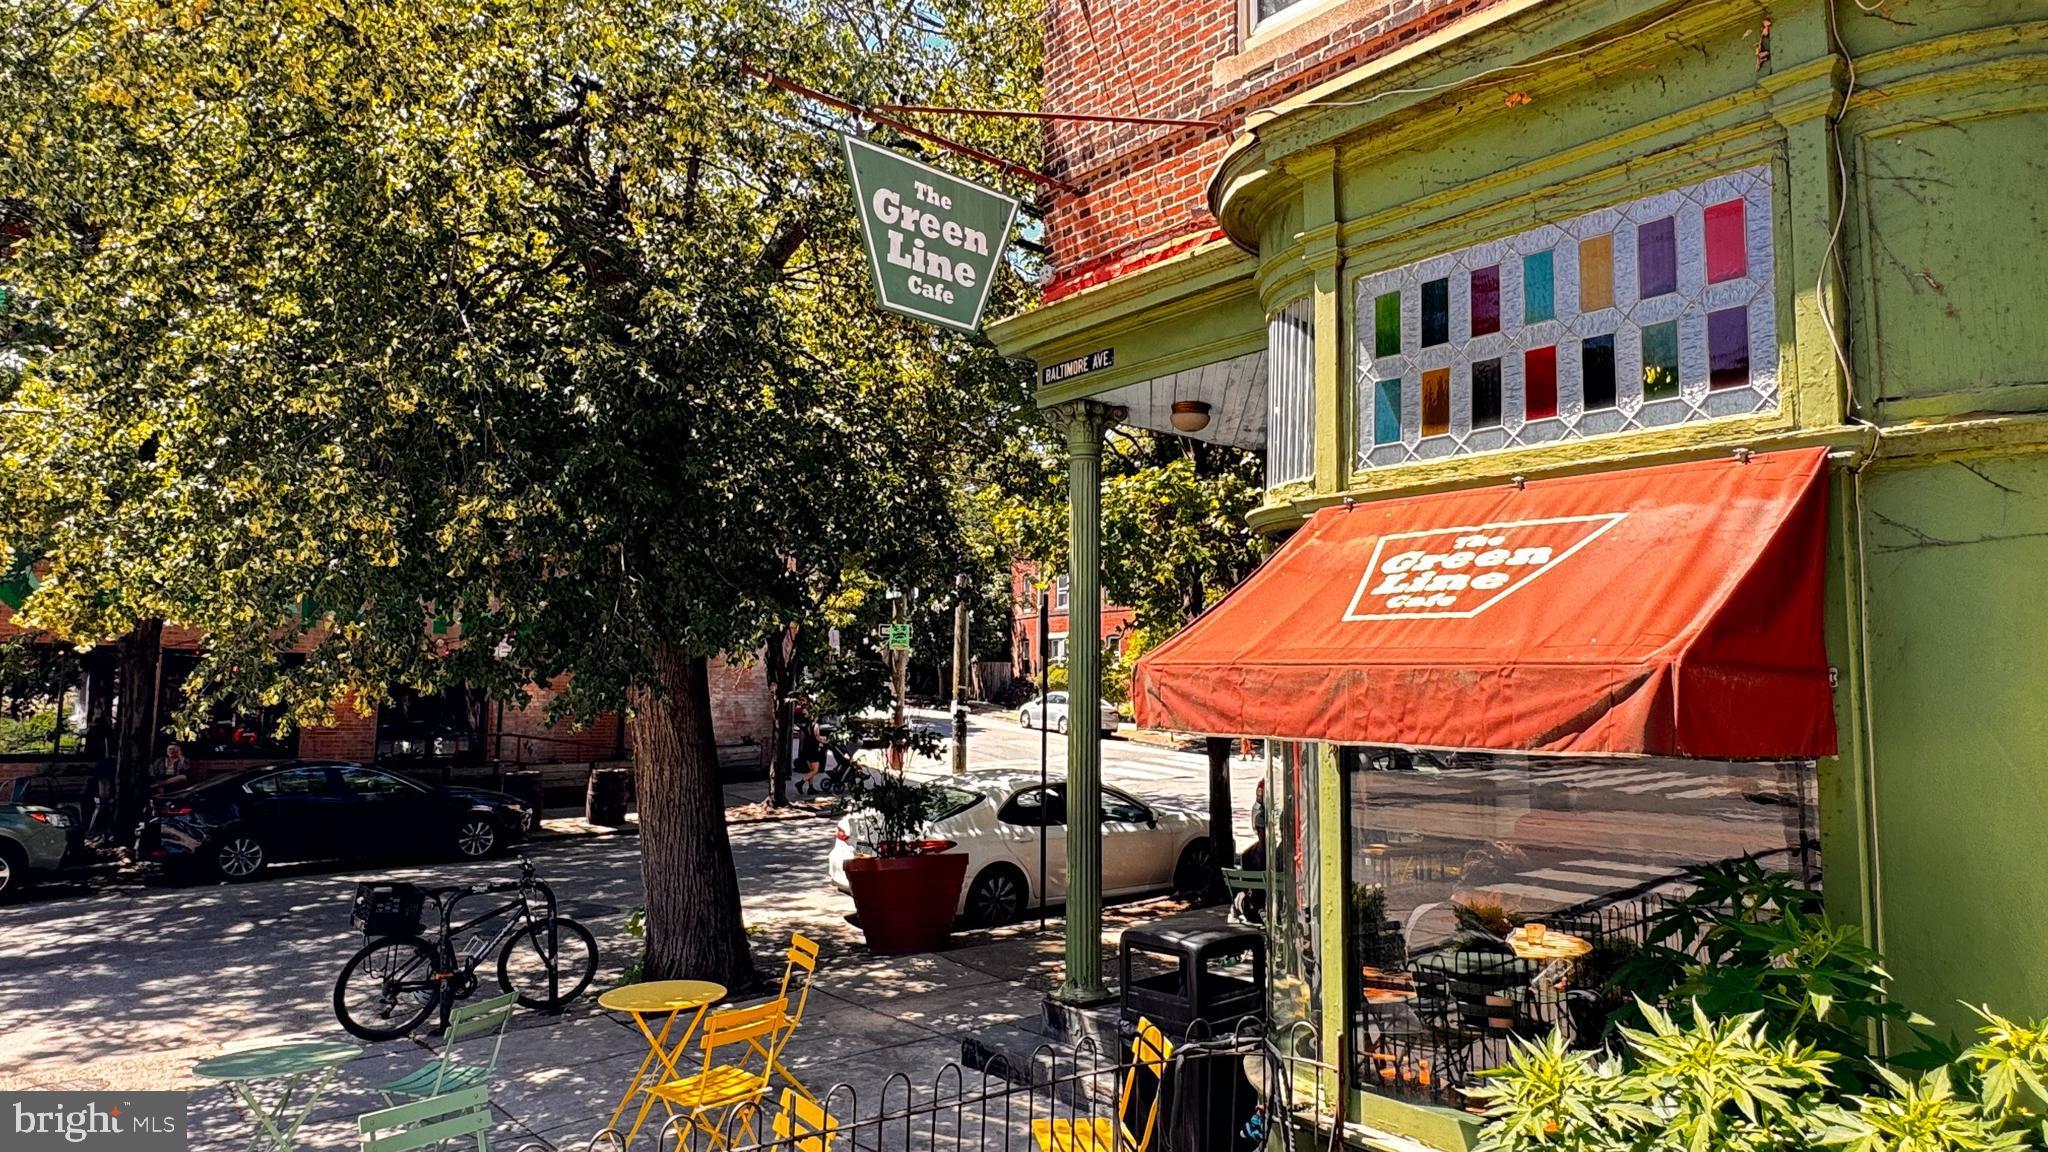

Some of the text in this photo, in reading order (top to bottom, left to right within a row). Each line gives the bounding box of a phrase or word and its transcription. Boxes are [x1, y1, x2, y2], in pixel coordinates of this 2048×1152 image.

[914, 180, 952, 210] The
[873, 188, 989, 256] Green
[887, 229, 976, 288] Line
[907, 275, 954, 305] Cafe
[1045, 350, 1112, 383] BALTIMORE AVE.
[1453, 534, 1505, 549] The
[1381, 547, 1553, 574] Green
[1371, 571, 1510, 595] Line
[1386, 593, 1457, 608] Cafe
